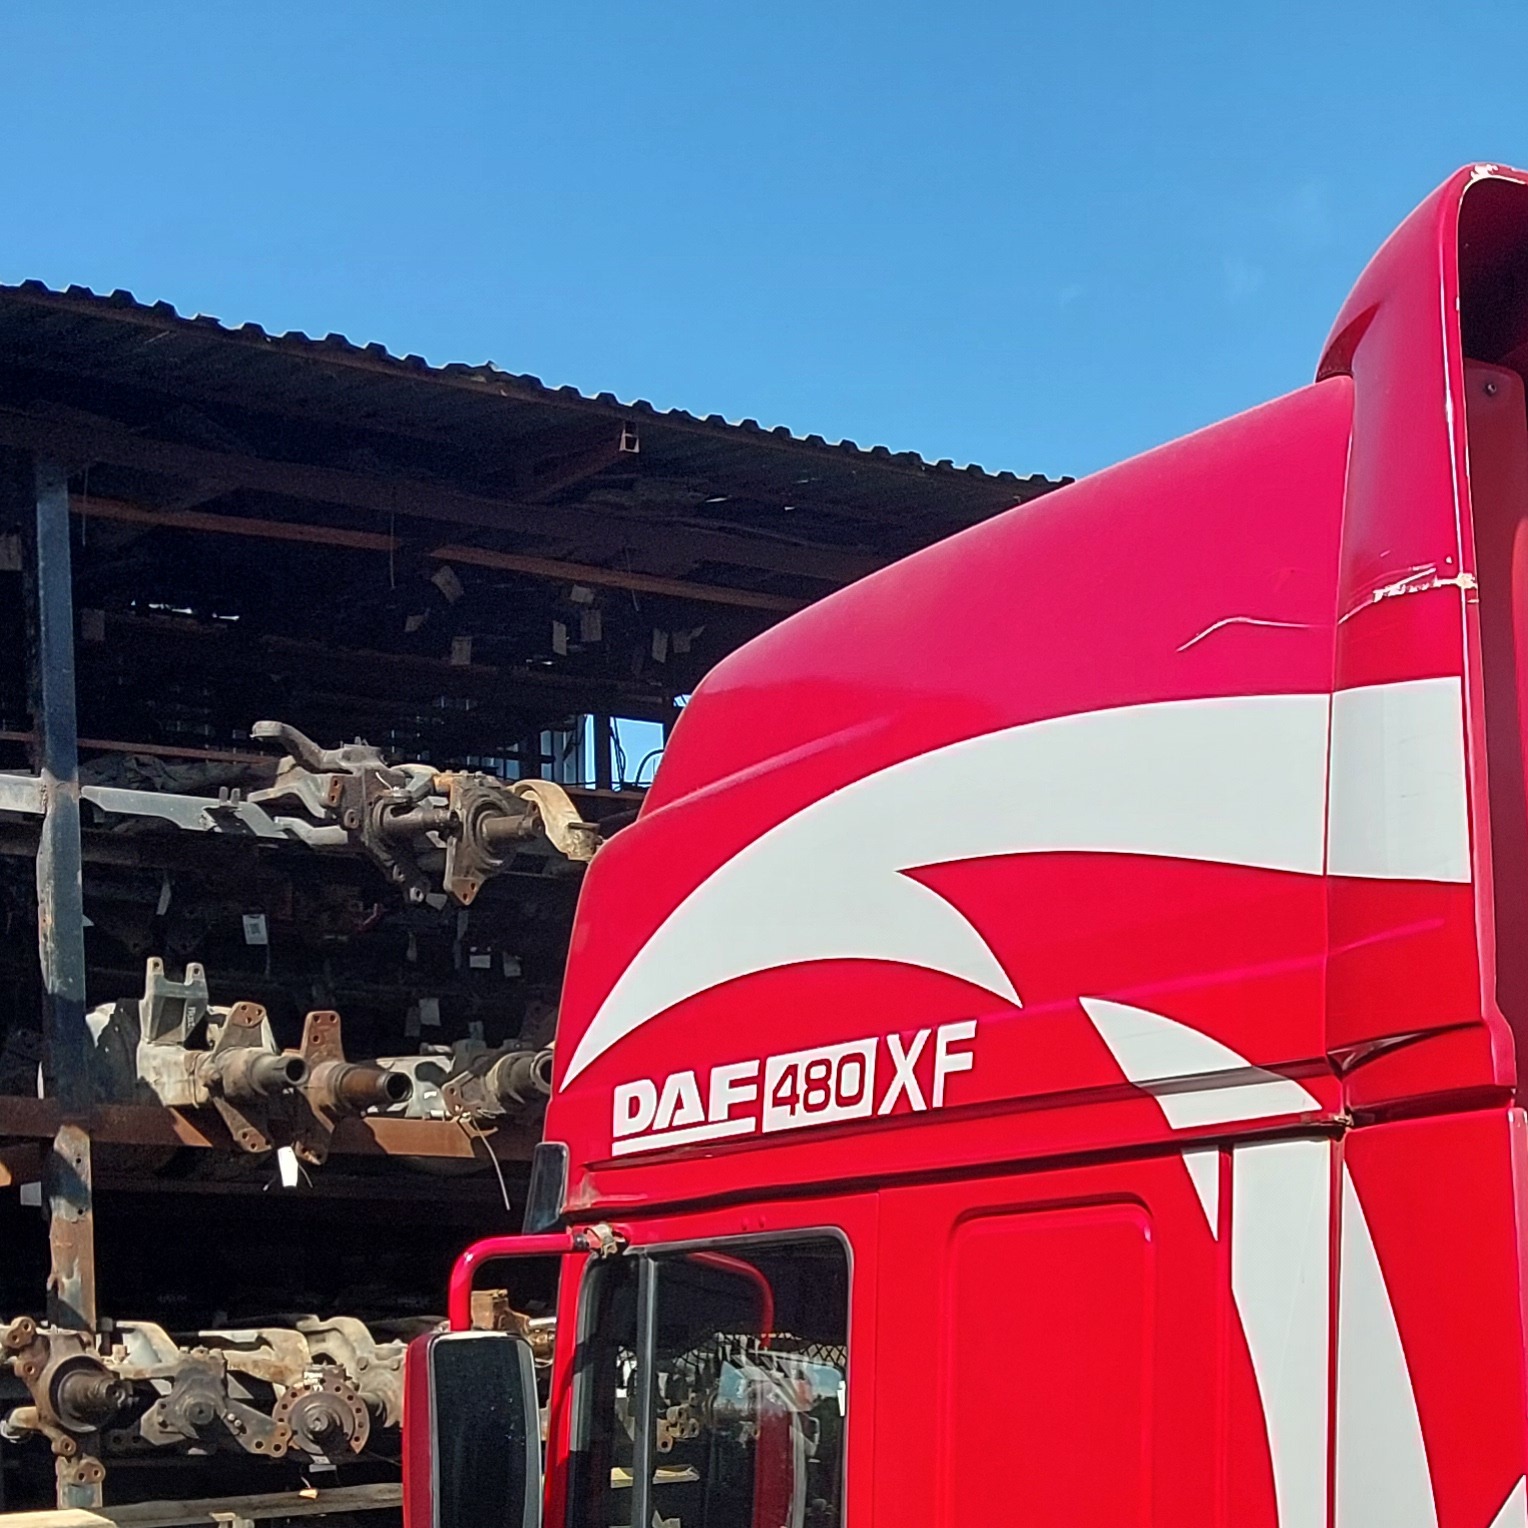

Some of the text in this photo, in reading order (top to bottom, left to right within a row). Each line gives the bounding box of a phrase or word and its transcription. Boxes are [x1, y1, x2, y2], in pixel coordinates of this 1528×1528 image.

[612, 1019, 977, 1139] DAF 480 XF
